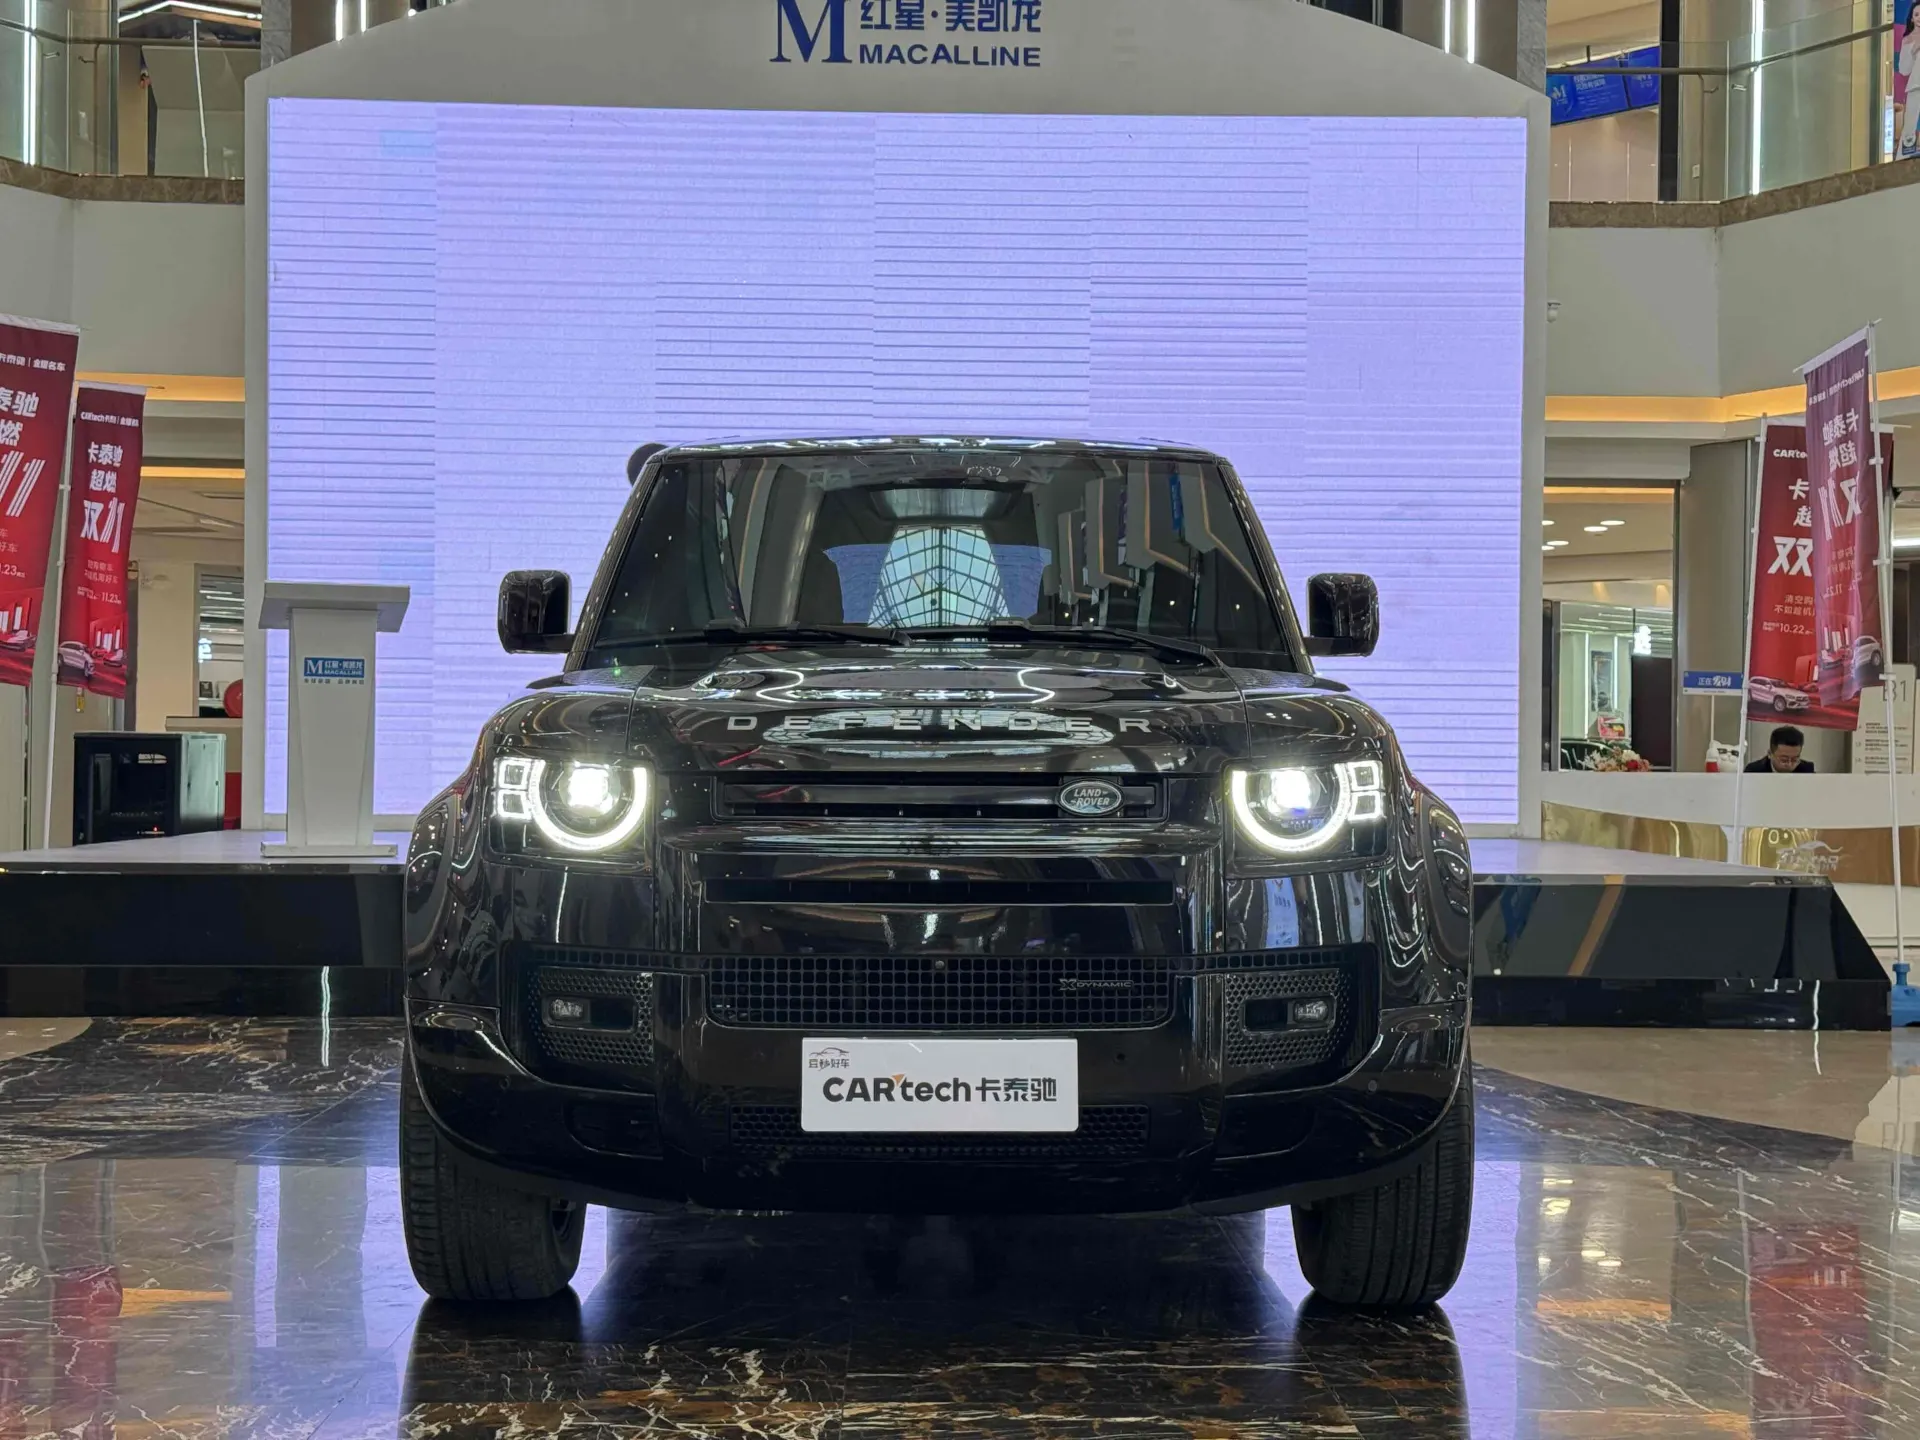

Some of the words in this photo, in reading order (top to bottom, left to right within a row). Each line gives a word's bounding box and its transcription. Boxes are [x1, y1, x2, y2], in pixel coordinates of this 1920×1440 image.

[859, 44, 1041, 67] MACALLINE
[726, 715, 1153, 733] DEFENDER
[1073, 788, 1102, 797] LAND
[1076, 797, 1110, 806] ROVER
[975, 1077, 1057, 1102] 卡泰驰
